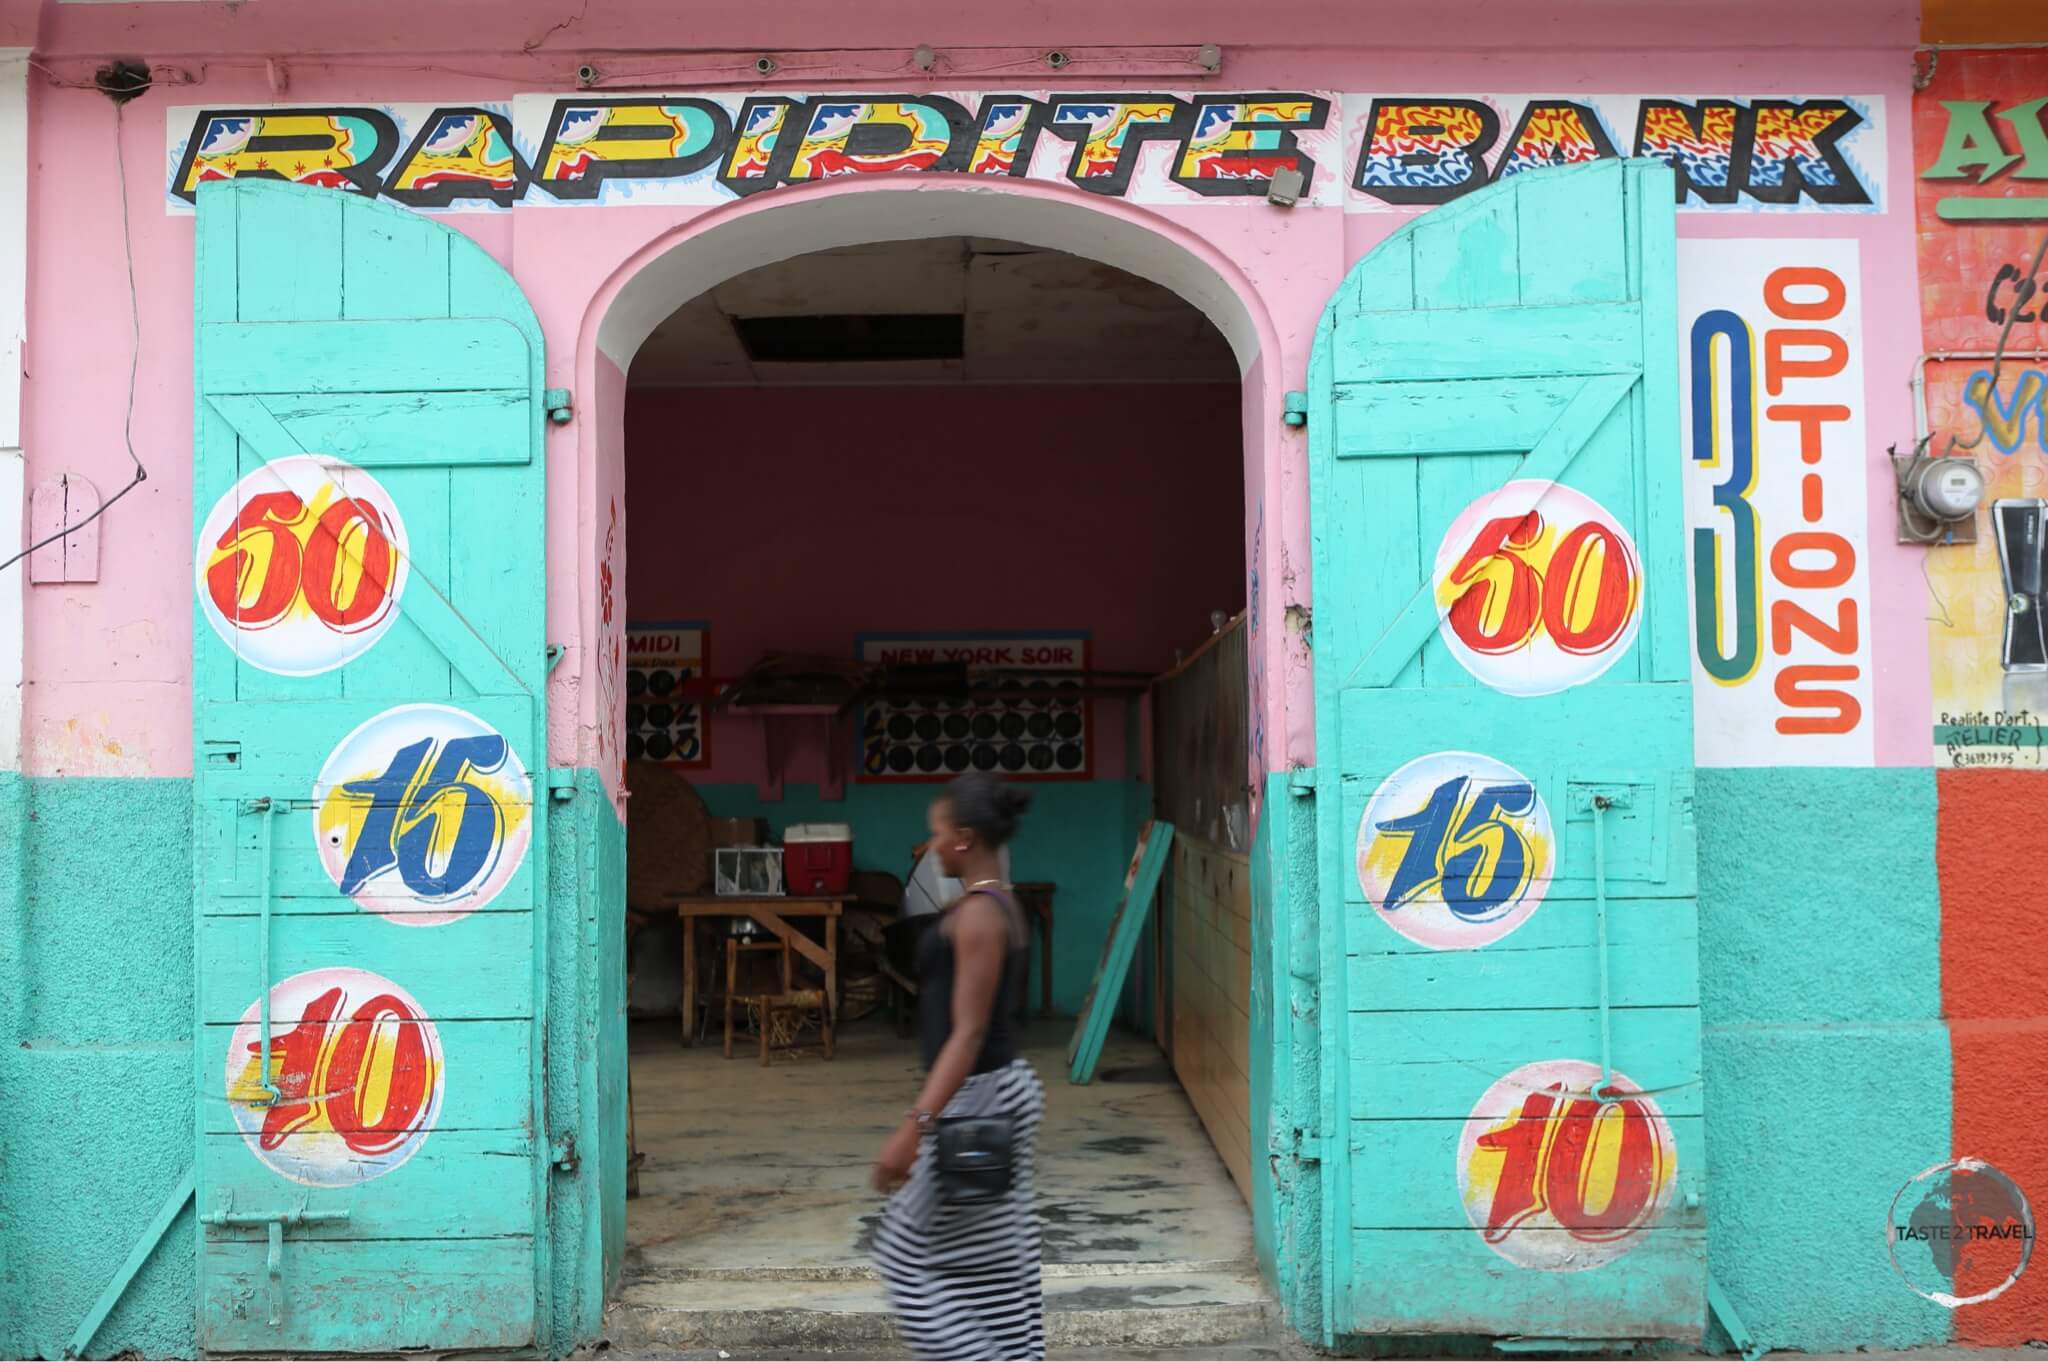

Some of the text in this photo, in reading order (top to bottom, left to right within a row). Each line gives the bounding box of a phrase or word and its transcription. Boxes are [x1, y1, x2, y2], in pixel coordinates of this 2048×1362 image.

[171, 94, 1873, 206] RAPIDITE BANK
[207, 490, 397, 634] 50
[1690, 266, 1862, 735] 3 OPTIONS
[627, 635, 681, 654] MIDI
[1448, 510, 1638, 655] 50
[881, 647, 1073, 666] NEW YORK SOIR
[1945, 727, 2021, 756] ATELIER
[340, 734, 509, 904] 15
[1376, 775, 1536, 924] 15
[247, 986, 435, 1156] 10
[1476, 1082, 1663, 1243] 10
